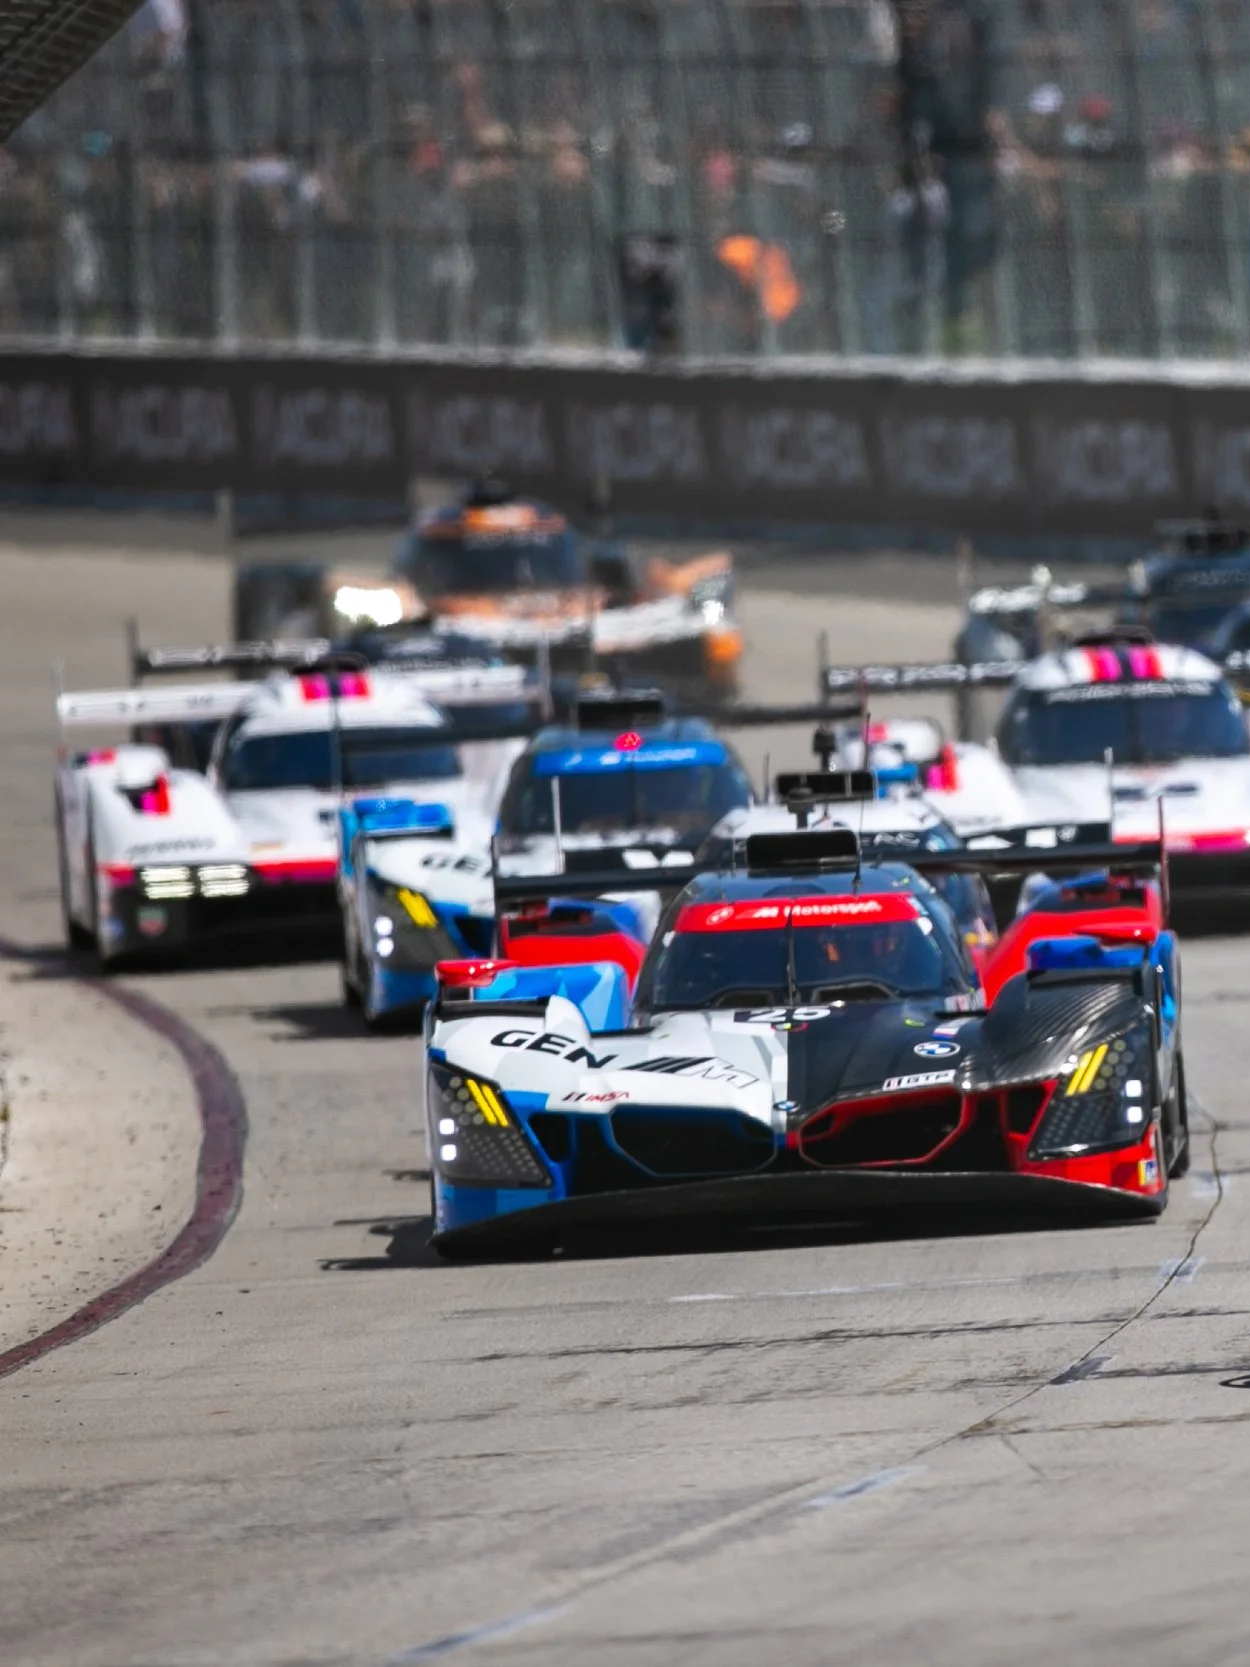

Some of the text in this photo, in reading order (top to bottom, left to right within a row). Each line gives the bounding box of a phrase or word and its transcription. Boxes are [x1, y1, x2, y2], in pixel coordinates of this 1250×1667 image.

[421, 852, 490, 878] GE
[748, 1008, 831, 1022] 25
[490, 1030, 620, 1069] GEN
[585, 1090, 630, 1102] IMSA
